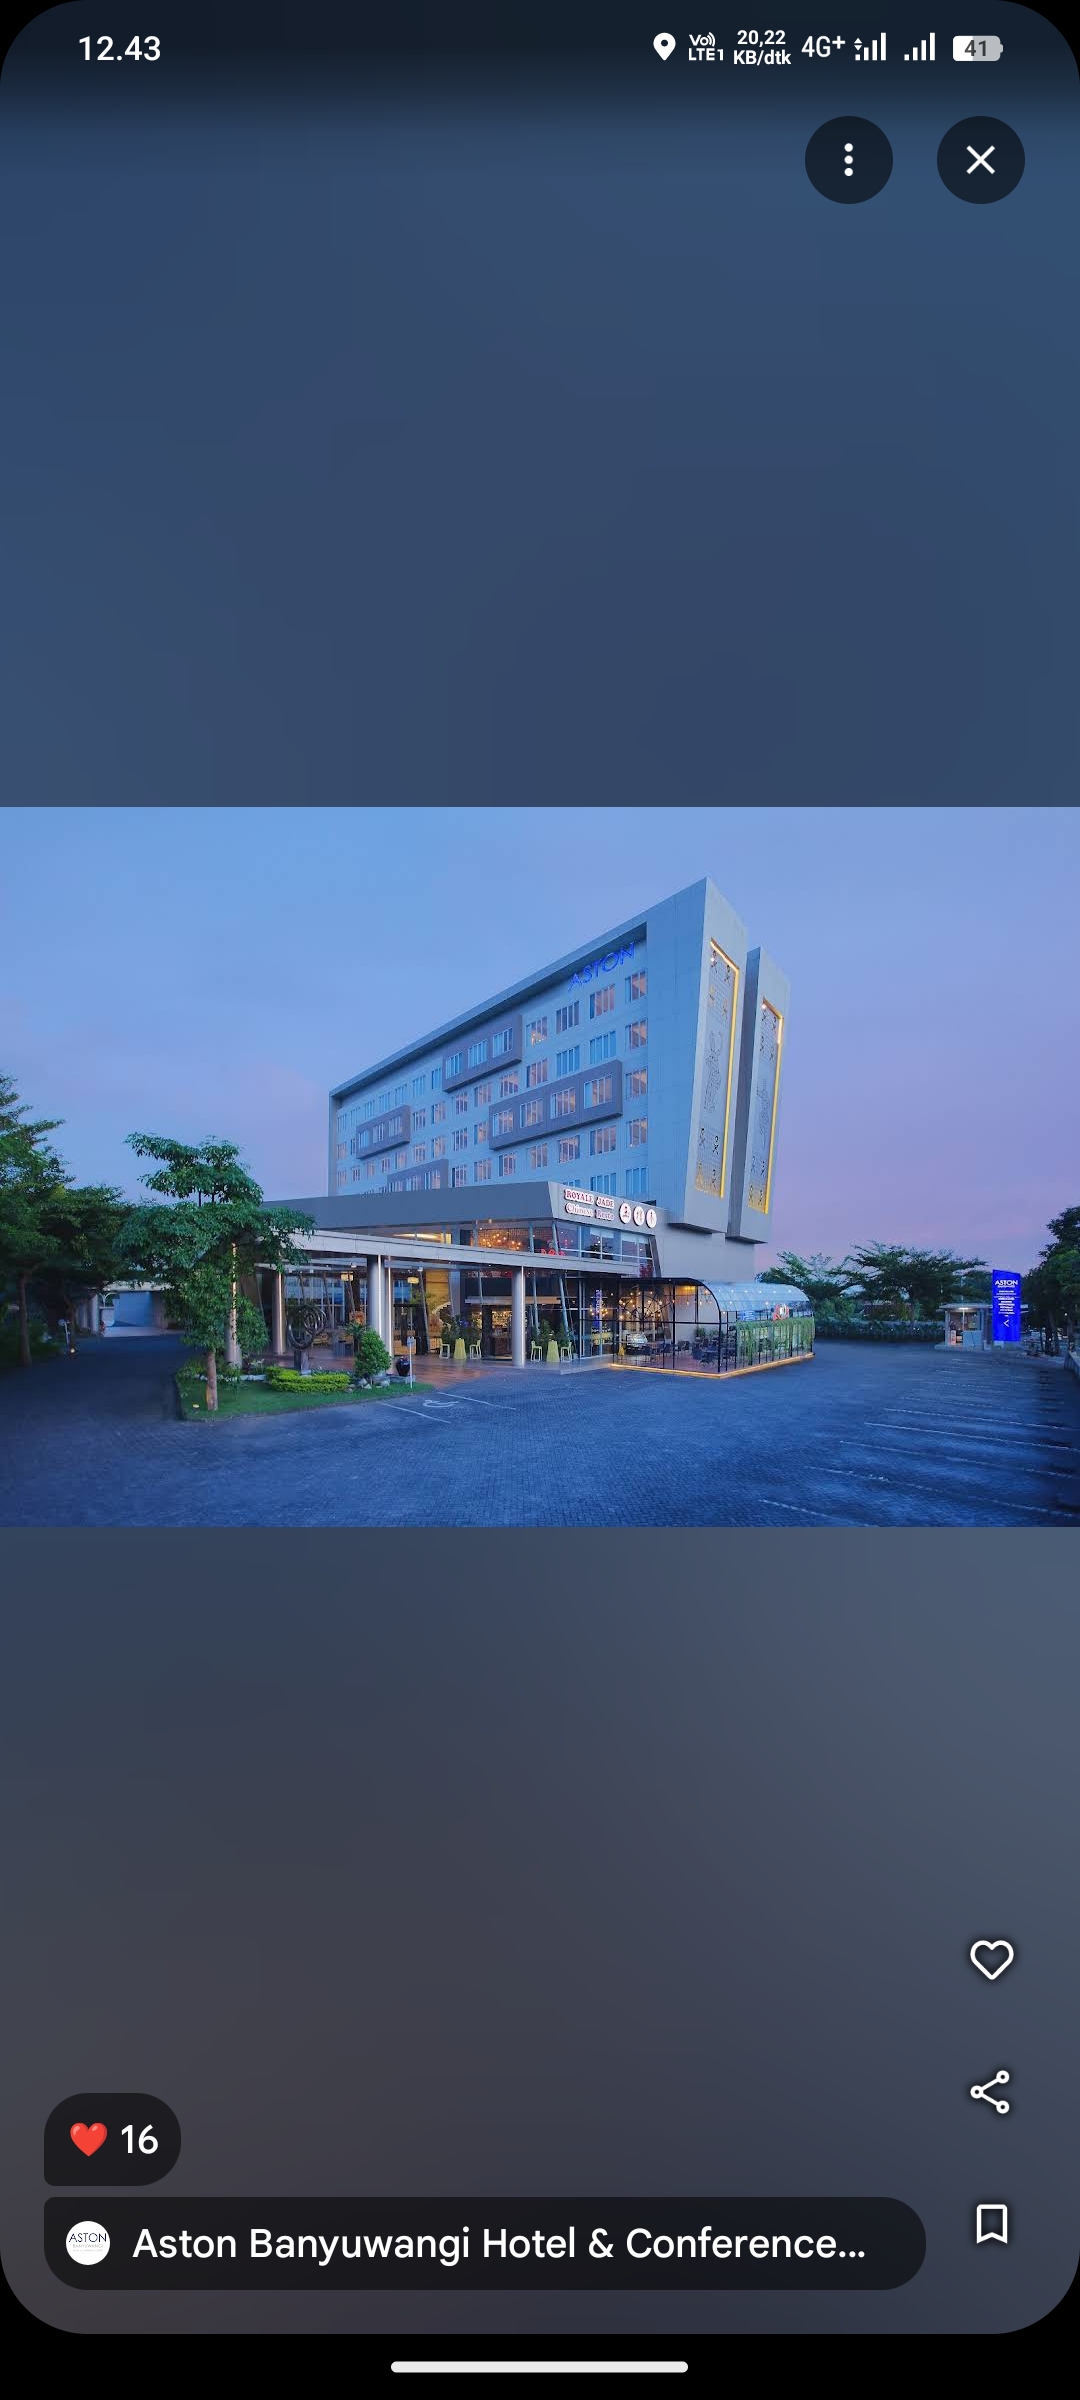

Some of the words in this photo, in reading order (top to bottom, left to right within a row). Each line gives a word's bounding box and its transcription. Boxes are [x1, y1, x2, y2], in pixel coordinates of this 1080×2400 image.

[568, 942, 635, 991] ASTON
[566, 1190, 593, 1203] ROYALE
[597, 1196, 614, 1208] JADE
